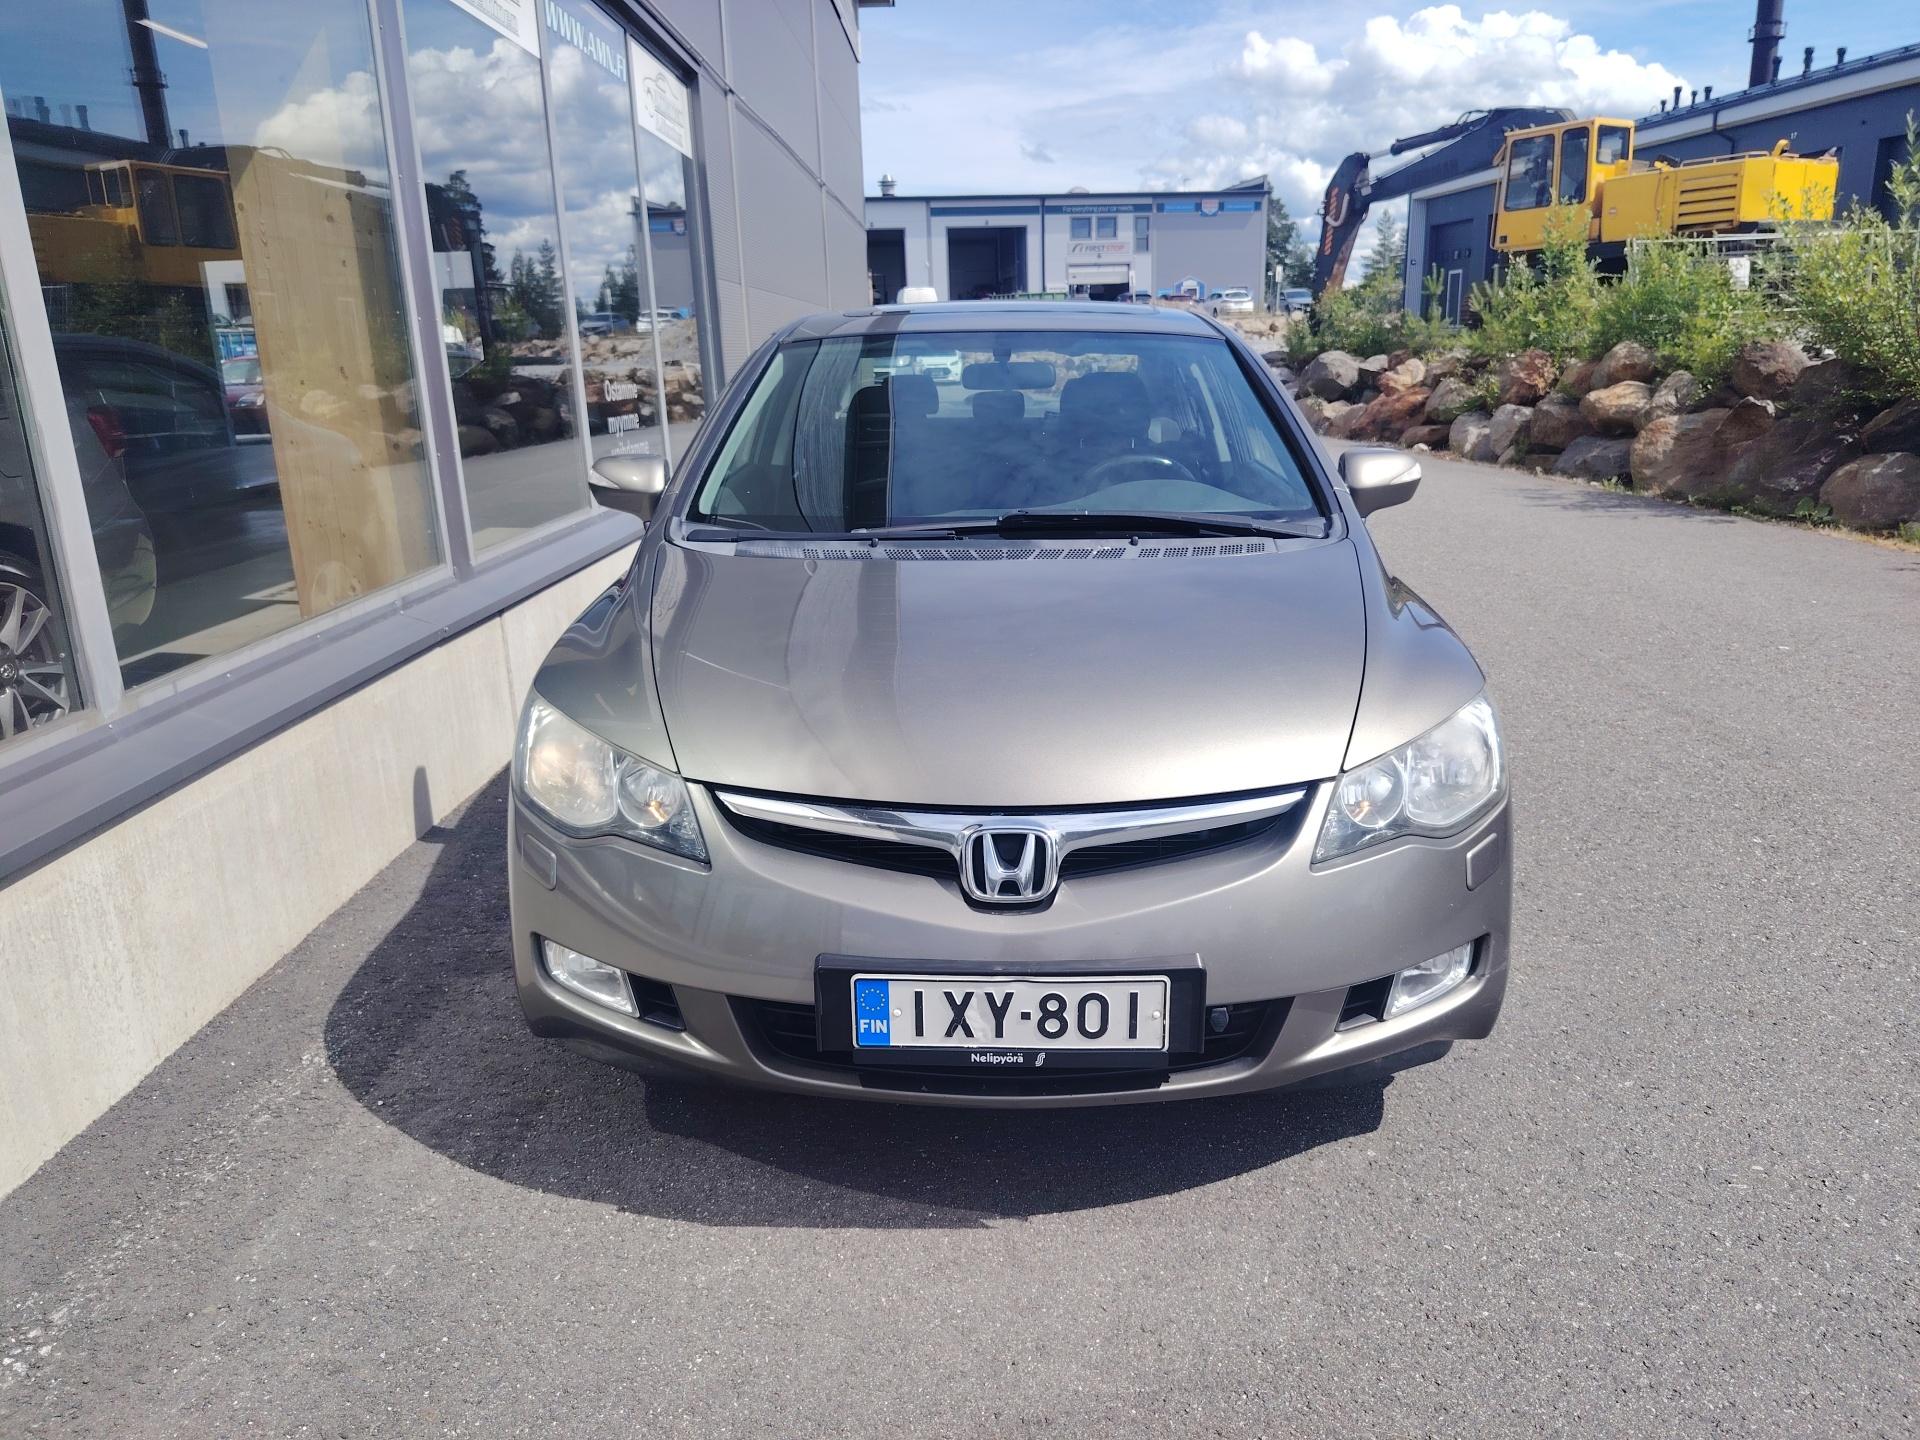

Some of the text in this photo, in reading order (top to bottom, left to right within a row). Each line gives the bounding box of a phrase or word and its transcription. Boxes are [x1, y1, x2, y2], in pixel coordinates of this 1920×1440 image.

[604, 380, 638, 402] Ostamme
[607, 413, 640, 438] myymme
[914, 990, 1139, 1040] IXY-801
[859, 1019, 887, 1034] FIN
[971, 1052, 1024, 1066] Nelipyörä
